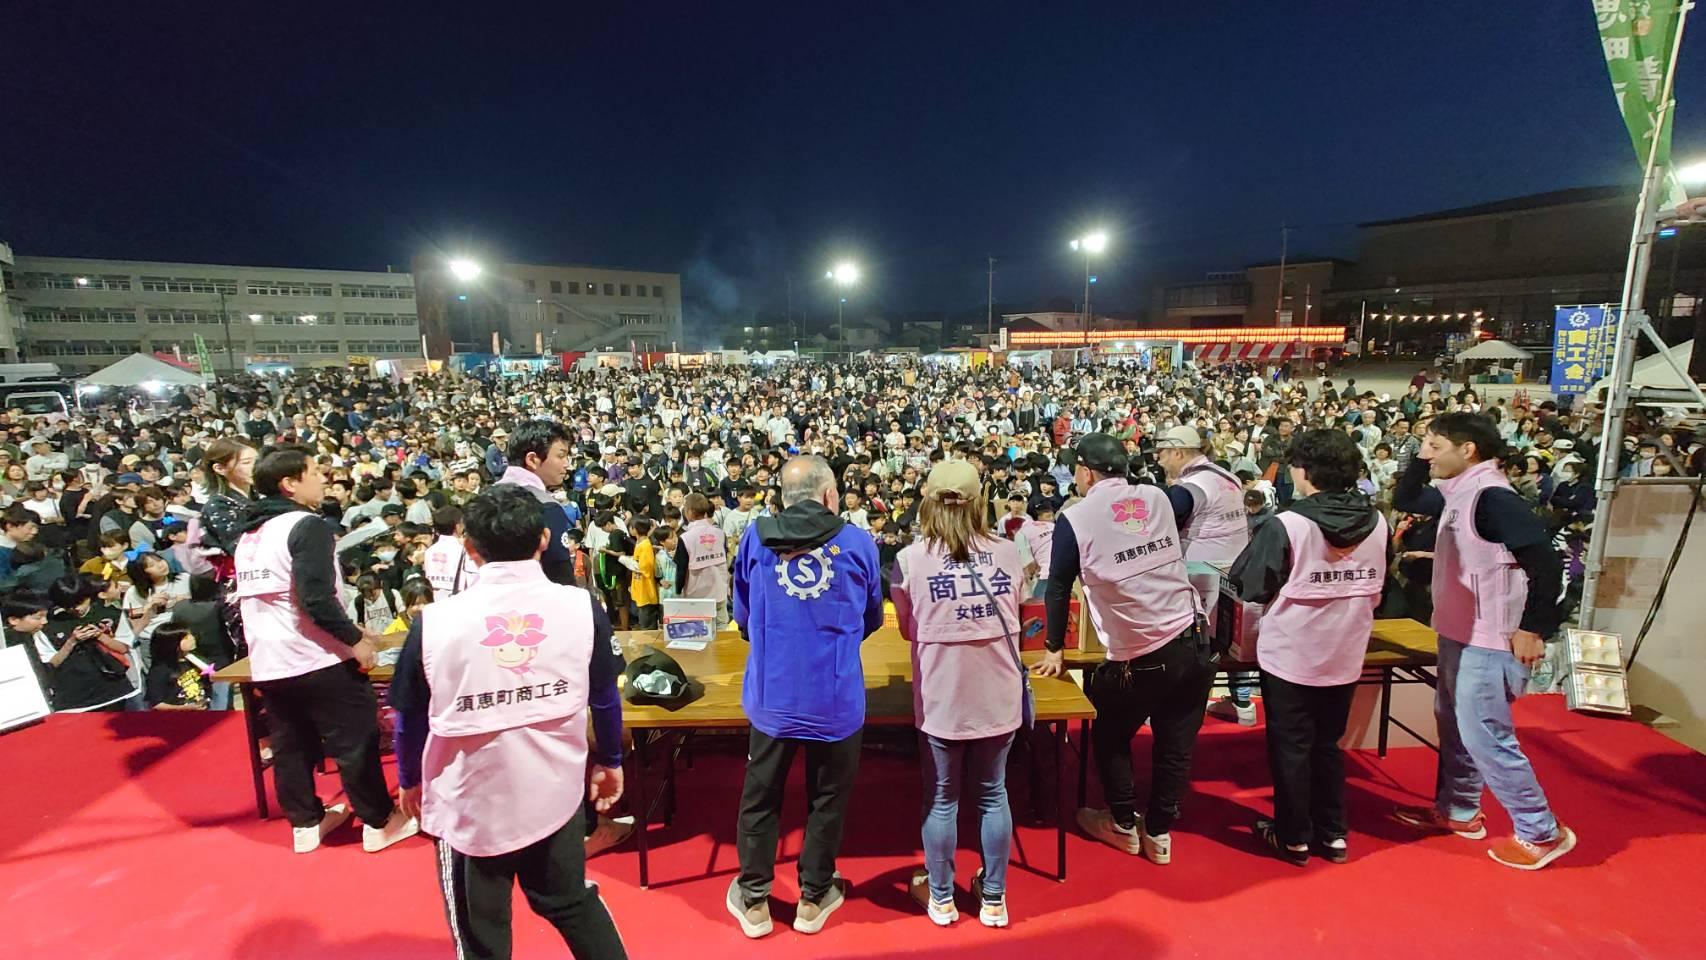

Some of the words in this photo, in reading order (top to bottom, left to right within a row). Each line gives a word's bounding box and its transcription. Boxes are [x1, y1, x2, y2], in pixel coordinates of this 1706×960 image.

[1114, 536, 1173, 564] 須恵町商工会
[927, 568, 1011, 602] 商工会
[1309, 568, 1377, 583] 須恵町商工会
[456, 679, 569, 712] 須恵町商工会
